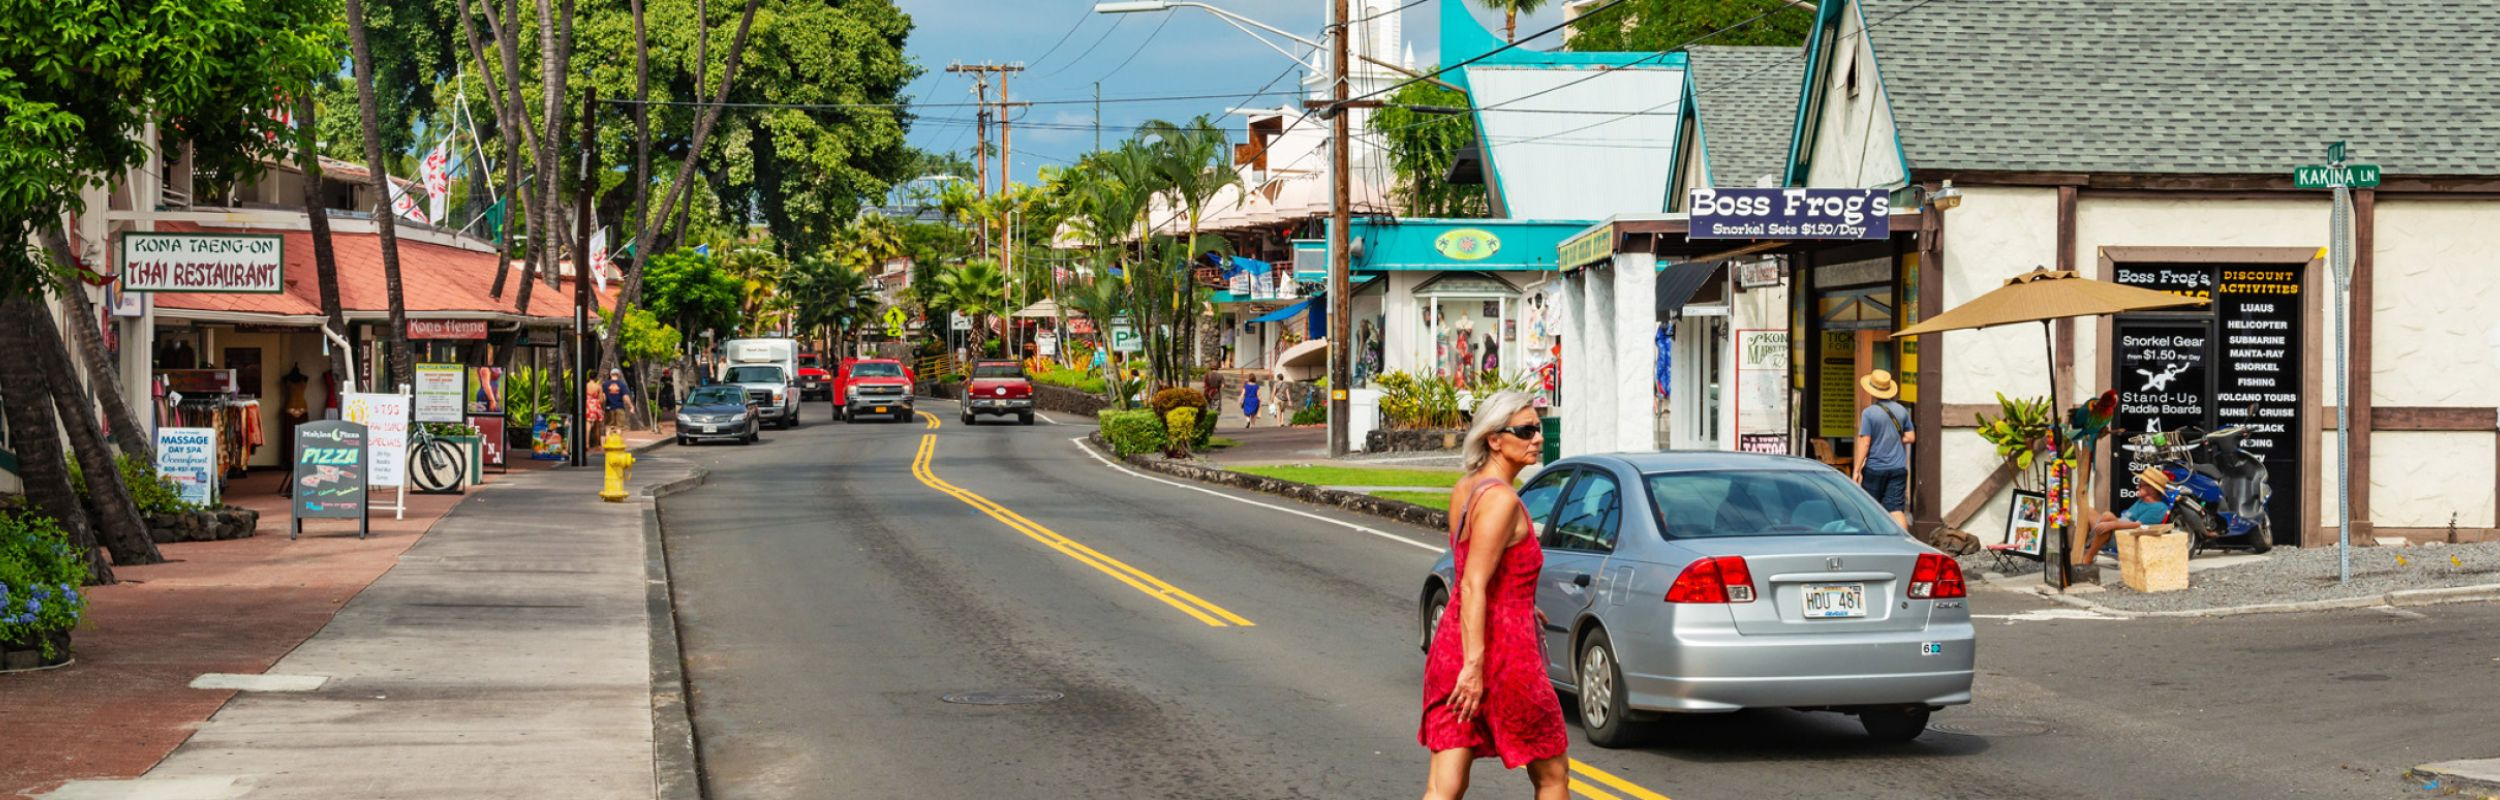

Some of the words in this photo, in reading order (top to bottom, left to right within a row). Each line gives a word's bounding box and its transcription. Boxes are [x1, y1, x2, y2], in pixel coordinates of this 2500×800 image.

[2300, 169, 2355, 185] KAKINA
[2361, 170, 2375, 181] LN
[1691, 189, 1770, 216] Boss
[1783, 189, 1888, 225] Frog's
[1712, 224, 1764, 234] Snorkel
[1768, 224, 1797, 235] Sets
[135, 239, 182, 252] KONA
[190, 239, 273, 254] TAENG-ON
[128, 258, 168, 287] THAI
[174, 260, 277, 288] RESTAURANT
[2118, 270, 2155, 283] Boss
[2224, 271, 2293, 280] DISCOUNT
[2219, 284, 2298, 294] ACTIVITIES
[2241, 304, 2274, 312] LUAUS
[409, 320, 440, 334] Kona
[2228, 321, 2287, 329] HELICOPTER
[2123, 336, 2170, 347] Snorkel
[2173, 336, 2205, 347] Gear
[2229, 336, 2285, 344] SUBMARINE
[2143, 349, 2176, 360] $1.50
[2230, 350, 2284, 358] MANTA-RAY
[2234, 363, 2279, 371] SNORKEL
[2238, 378, 2275, 386] FISHING
[2122, 393, 2197, 404] Stand-Up
[2218, 394, 2261, 402] VOLCANO
[2264, 394, 2296, 402] TOURS
[2122, 405, 2159, 414] Paddle
[2162, 405, 2202, 414] Boards
[2220, 408, 2256, 416] SUNS
[2259, 408, 2294, 416] CRUISE
[161, 436, 208, 444] MASSAGE
[2240, 439, 2273, 447] RDING
[1743, 443, 1786, 454] TATTOO
[301, 448, 358, 465] PIZZA
[1806, 592, 1830, 610] HDU
[1839, 592, 1860, 609] 487
